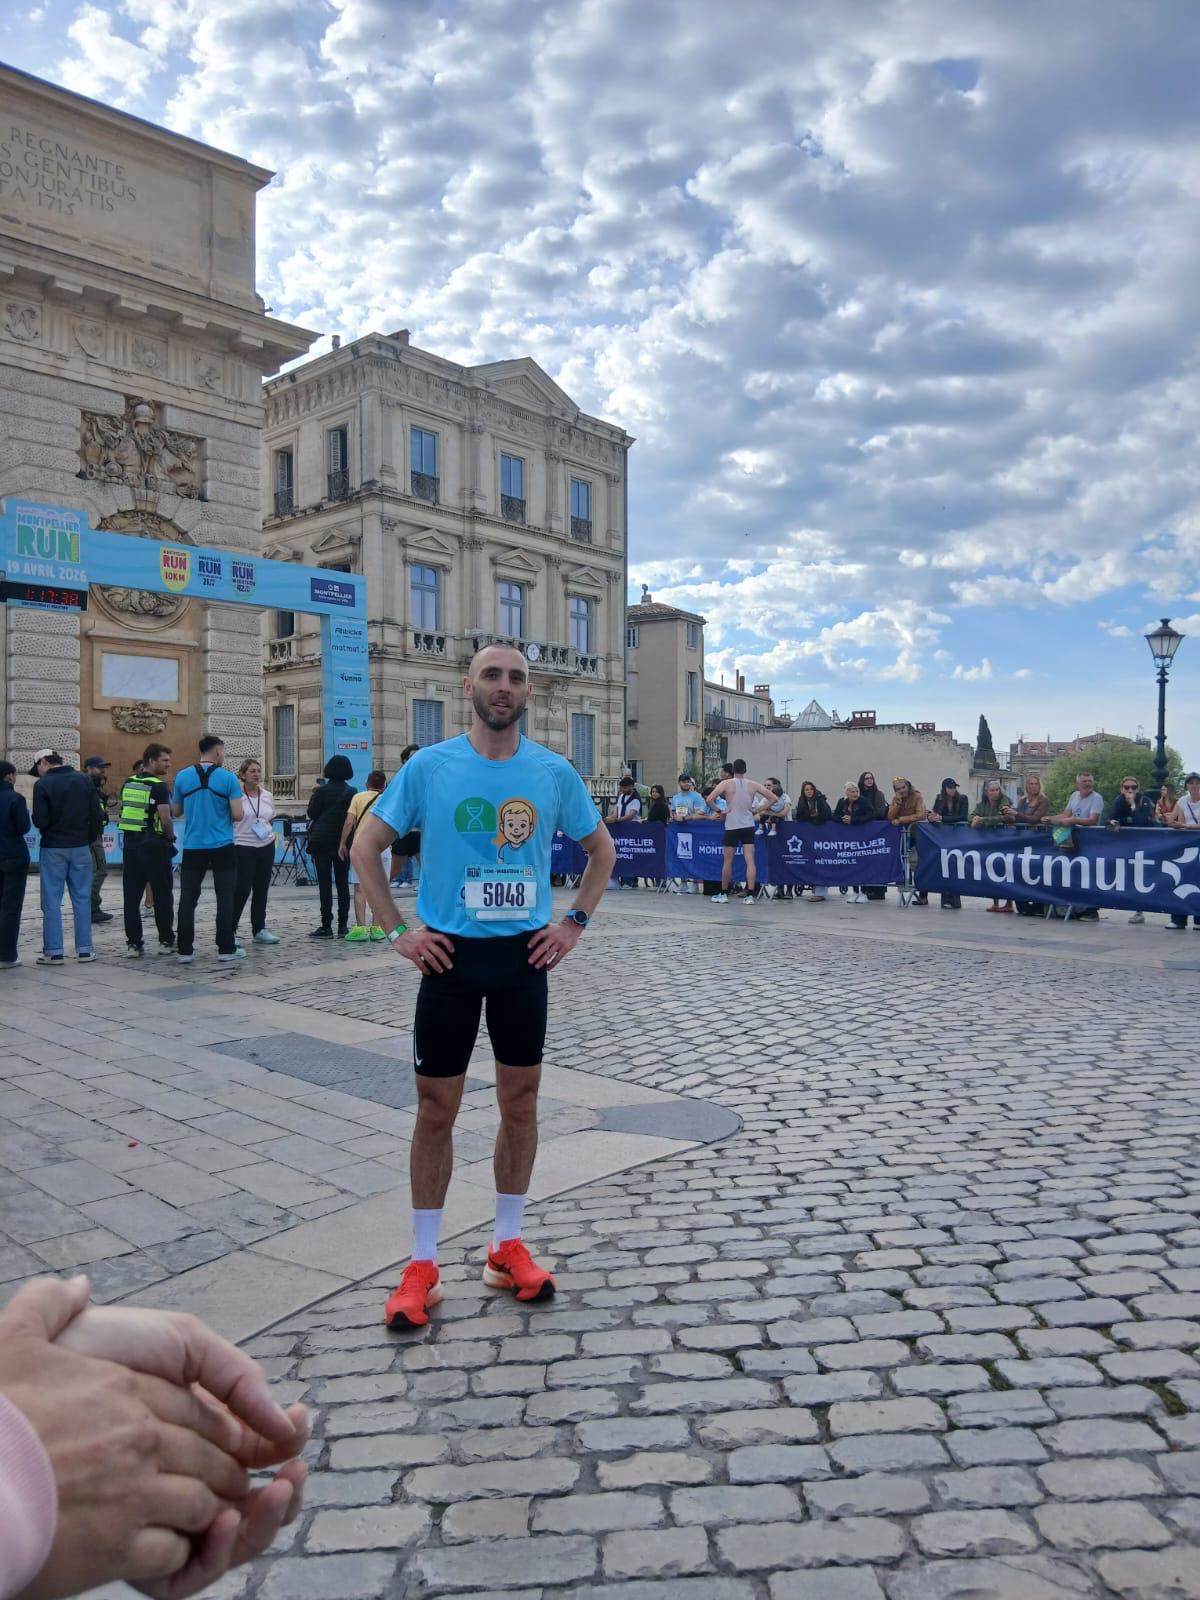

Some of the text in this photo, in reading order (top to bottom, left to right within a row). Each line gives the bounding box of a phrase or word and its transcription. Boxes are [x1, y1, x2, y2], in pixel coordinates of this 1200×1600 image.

[11, 127, 127, 180] REGNANTE
[0, 161, 114, 212] ONJURATIS
[24, 151, 137, 202] GENTIBUS
[17, 524, 80, 563] RUN
[7, 560, 87, 582] 19 AVRIL 2026
[163, 555, 187, 570] RUN
[198, 560, 222, 576] RUN
[231, 565, 254, 580] RUN
[612, 838, 654, 847] NTPELLIER
[814, 837, 886, 850] MONTPELLIER
[940, 846, 1156, 894] matmut
[483, 882, 525, 907] 5048
